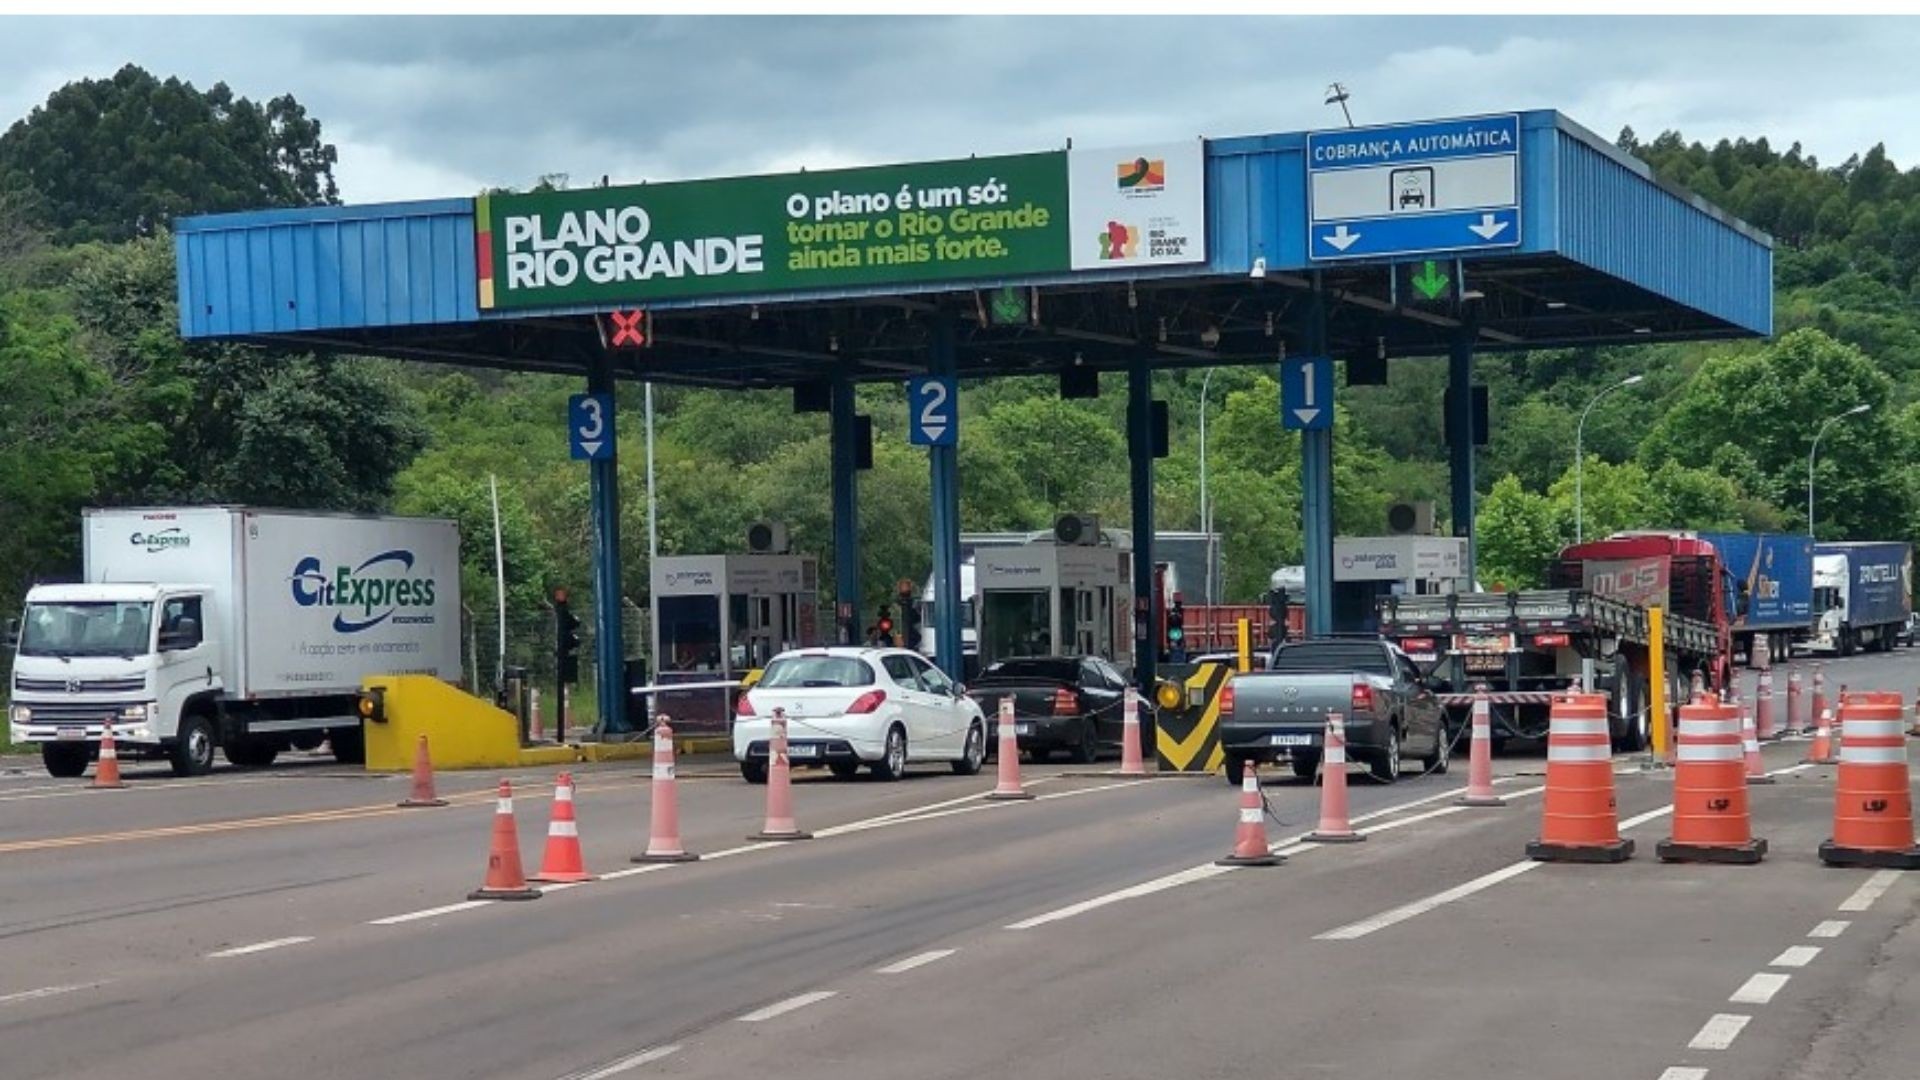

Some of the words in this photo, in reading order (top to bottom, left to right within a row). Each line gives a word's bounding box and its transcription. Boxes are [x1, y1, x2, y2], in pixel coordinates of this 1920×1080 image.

[1314, 138, 1402, 161] COBRANÇA
[1407, 127, 1512, 152] AUTOMÁTICA
[786, 194, 810, 220] O
[814, 190, 890, 221] plano
[895, 184, 914, 211] é
[918, 183, 963, 209] um
[966, 177, 1008, 206] só:
[505, 206, 650, 253] PLANO
[787, 219, 868, 244] tornar
[874, 219, 893, 239] o
[899, 207, 944, 237] Rio
[948, 203, 1049, 232] Grande
[1149, 237, 1188, 247] GRANDE
[508, 250, 579, 289] RIO
[584, 235, 764, 284] GRANDE
[788, 242, 861, 270] ainda
[866, 238, 931, 267] mais
[935, 232, 1008, 262] forte.
[1150, 248, 1164, 257] DO
[1165, 247, 1183, 256] SUL
[920, 380, 947, 424] 2
[1301, 362, 1316, 406] 1
[580, 397, 603, 439] 3
[292, 556, 436, 617] CitExpress
